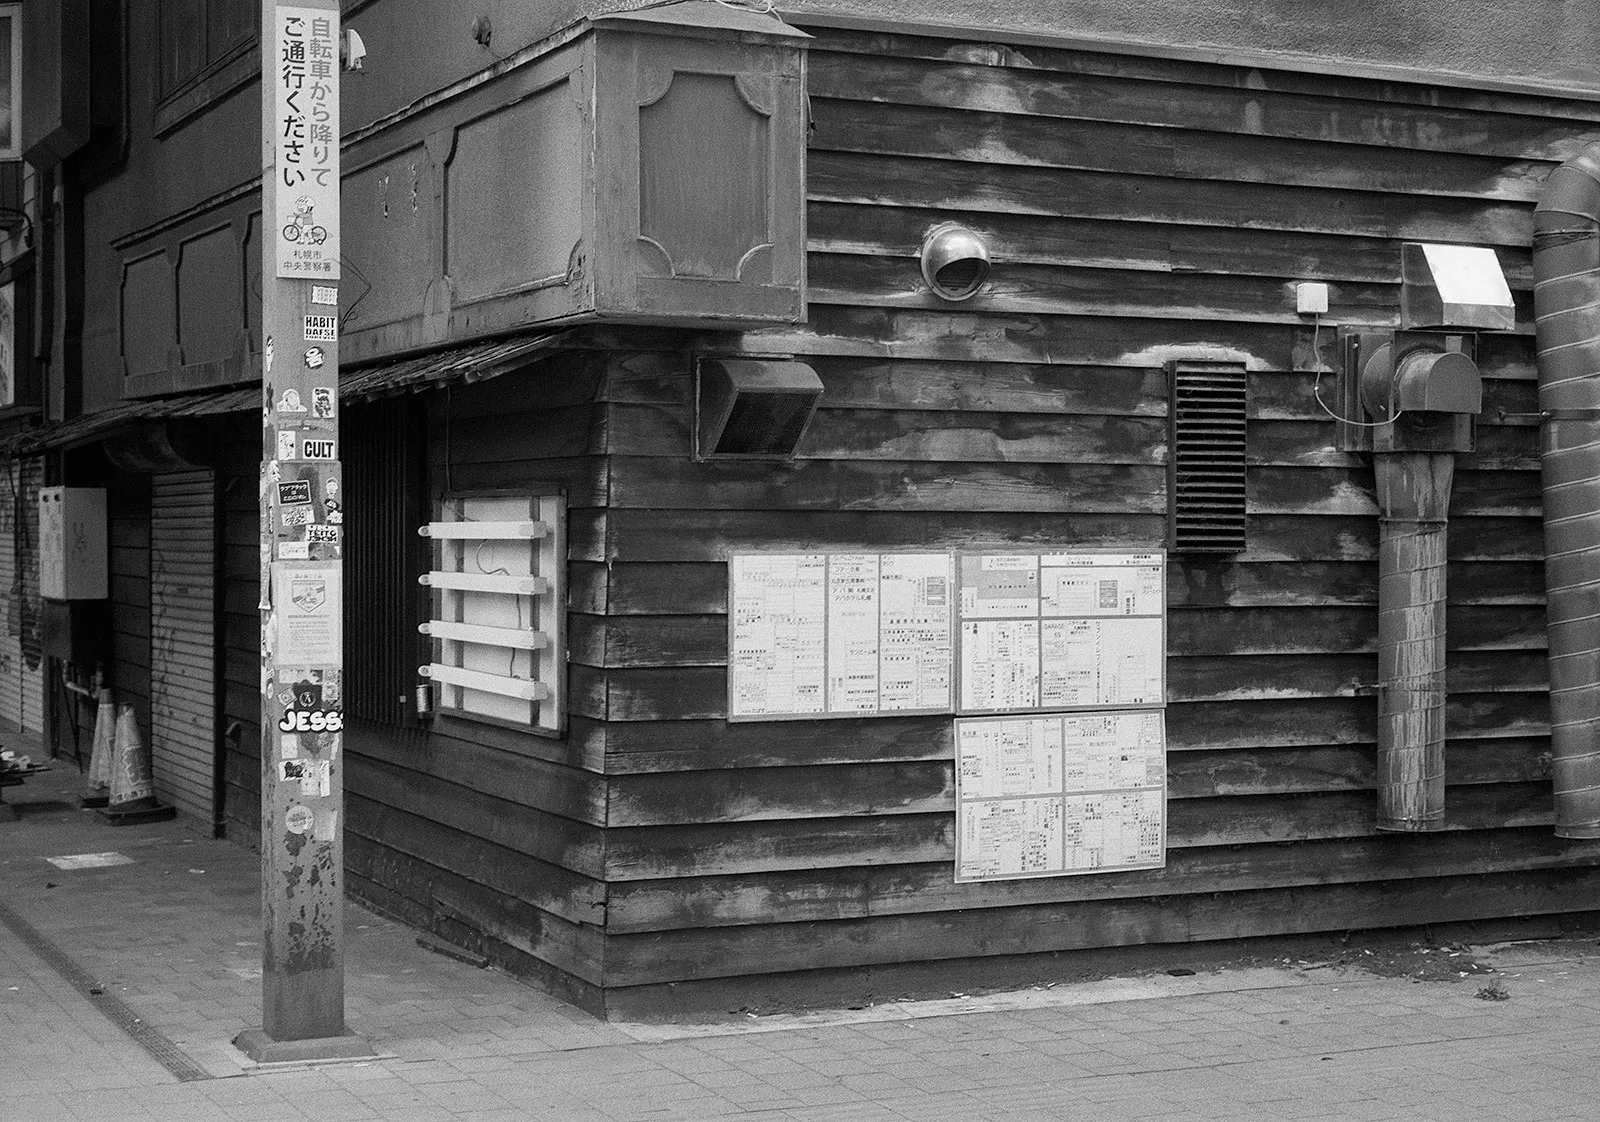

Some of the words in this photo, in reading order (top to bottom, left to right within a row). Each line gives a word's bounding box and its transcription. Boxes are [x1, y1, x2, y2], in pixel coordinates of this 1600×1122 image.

[282, 17, 305, 187] ご通行ください
[310, 17, 332, 187] 自転車から降りて
[293, 249, 322, 260] 札幌市
[284, 261, 331, 271] 中央警察署
[305, 316, 335, 328] HABIT
[304, 441, 334, 458] CULT
[280, 711, 343, 731] JESS
